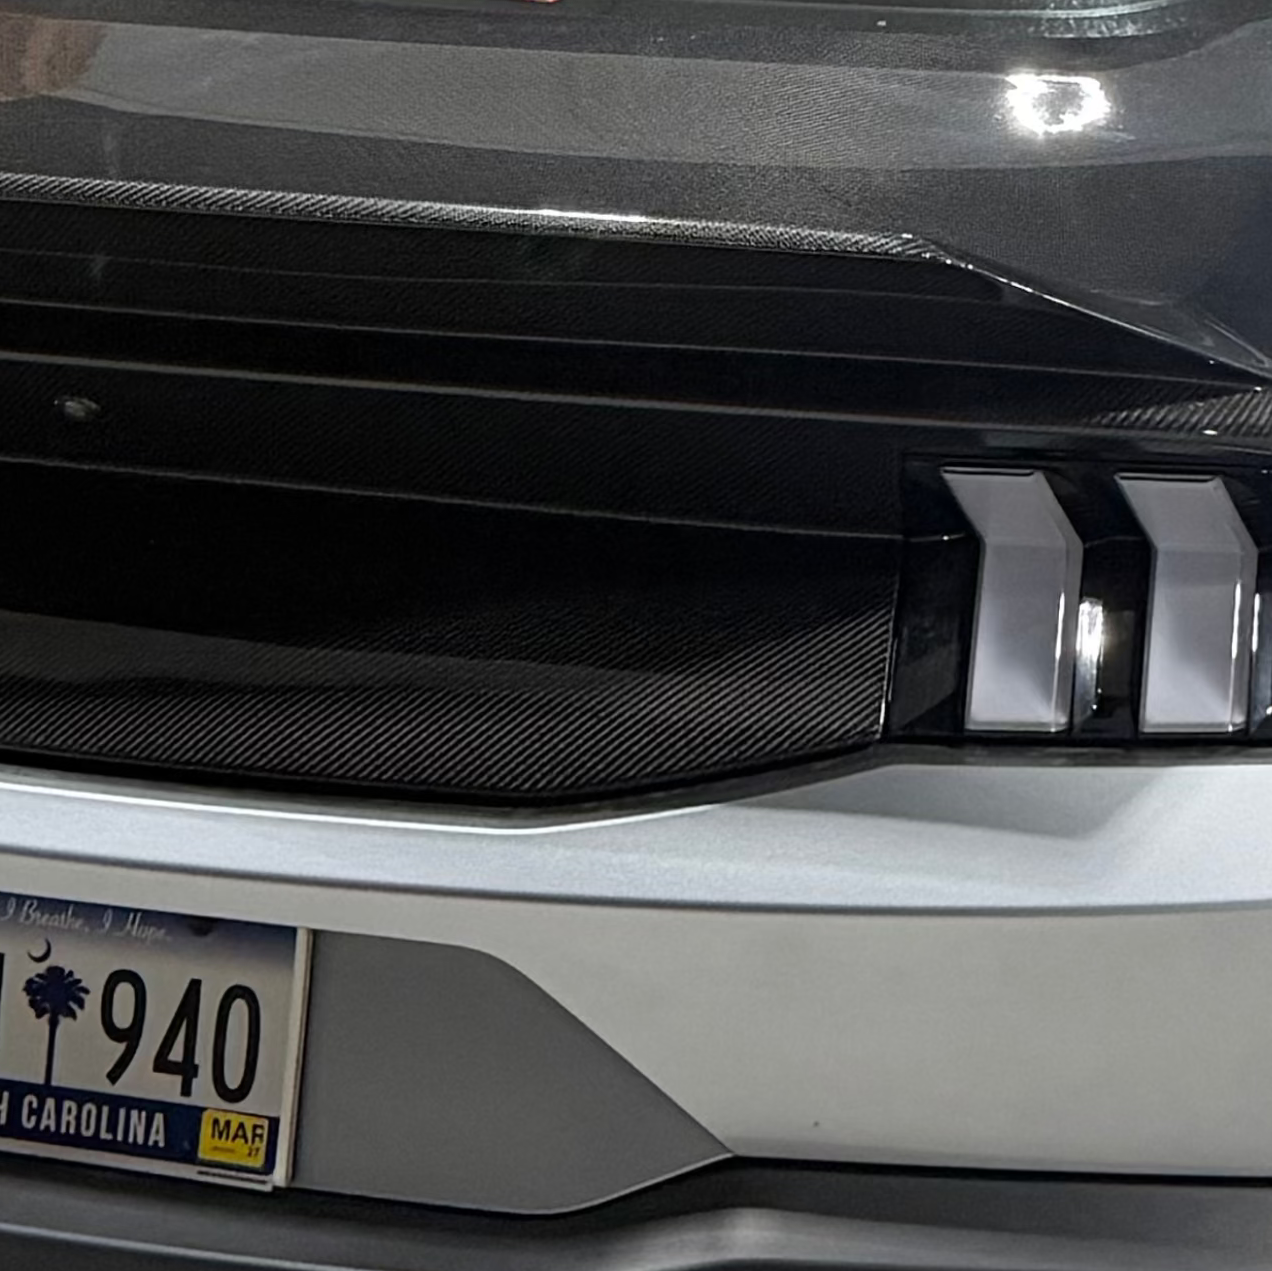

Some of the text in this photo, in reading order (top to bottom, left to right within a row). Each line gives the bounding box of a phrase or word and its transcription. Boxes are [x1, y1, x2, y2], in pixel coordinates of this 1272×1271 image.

[100, 968, 262, 1103] 940
[21, 1093, 167, 1149] CAROLINA
[211, 1117, 265, 1145] MAR
